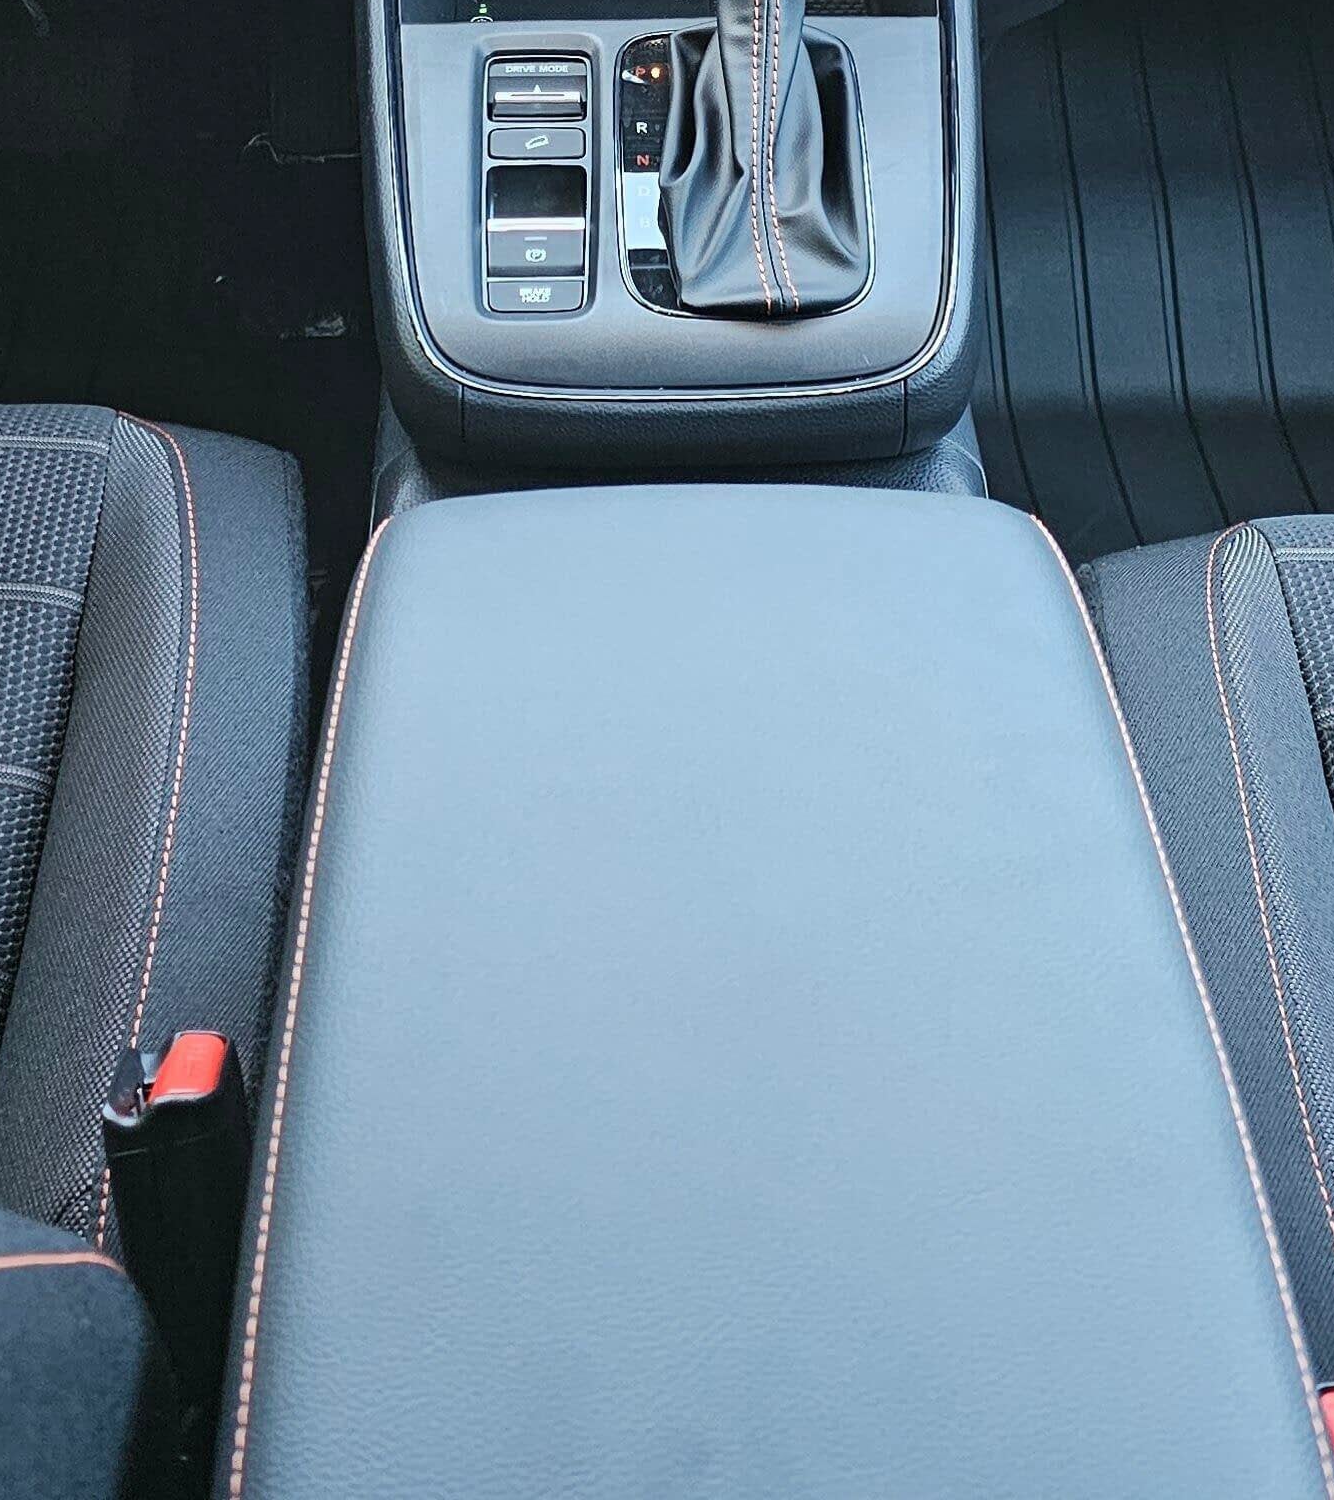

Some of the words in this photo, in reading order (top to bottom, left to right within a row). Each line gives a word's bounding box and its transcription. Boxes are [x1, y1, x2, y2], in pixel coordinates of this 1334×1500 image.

[505, 65, 536, 74] DRIVE
[538, 64, 569, 73] MODE
[635, 65, 646, 76] P
[636, 121, 648, 134] R
[637, 154, 650, 166] N
[639, 186, 651, 197] D
